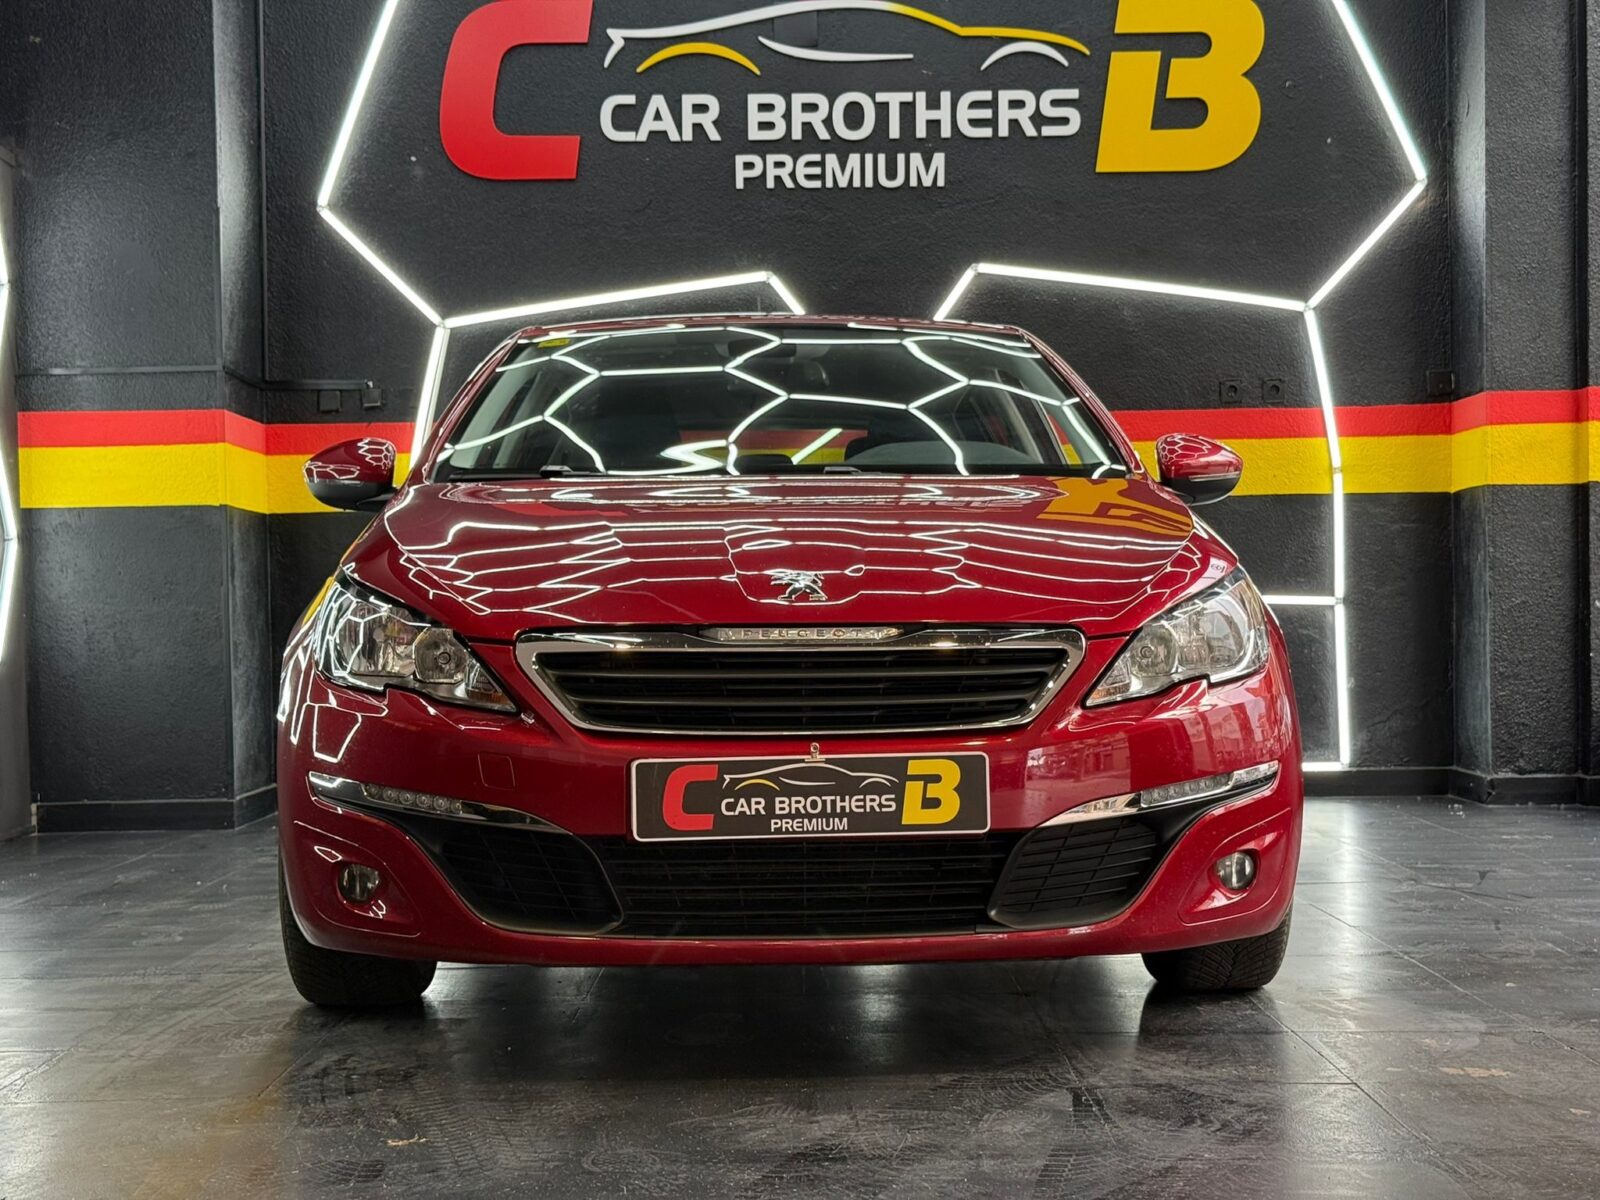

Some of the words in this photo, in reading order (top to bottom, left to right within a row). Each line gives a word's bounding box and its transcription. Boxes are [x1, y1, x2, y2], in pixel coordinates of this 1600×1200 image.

[439, 0, 593, 181] C
[1095, 0, 1266, 173] B
[600, 93, 722, 142] CAR
[747, 88, 1082, 141] BROTHERS
[735, 152, 946, 190] PREMIUM
[742, 628, 862, 638] PEUGEOT
[662, 763, 719, 831] C
[720, 797, 766, 816] CAR
[774, 794, 897, 815] BROTHERS
[901, 758, 961, 825] B
[770, 817, 848, 833] PREMIUM
